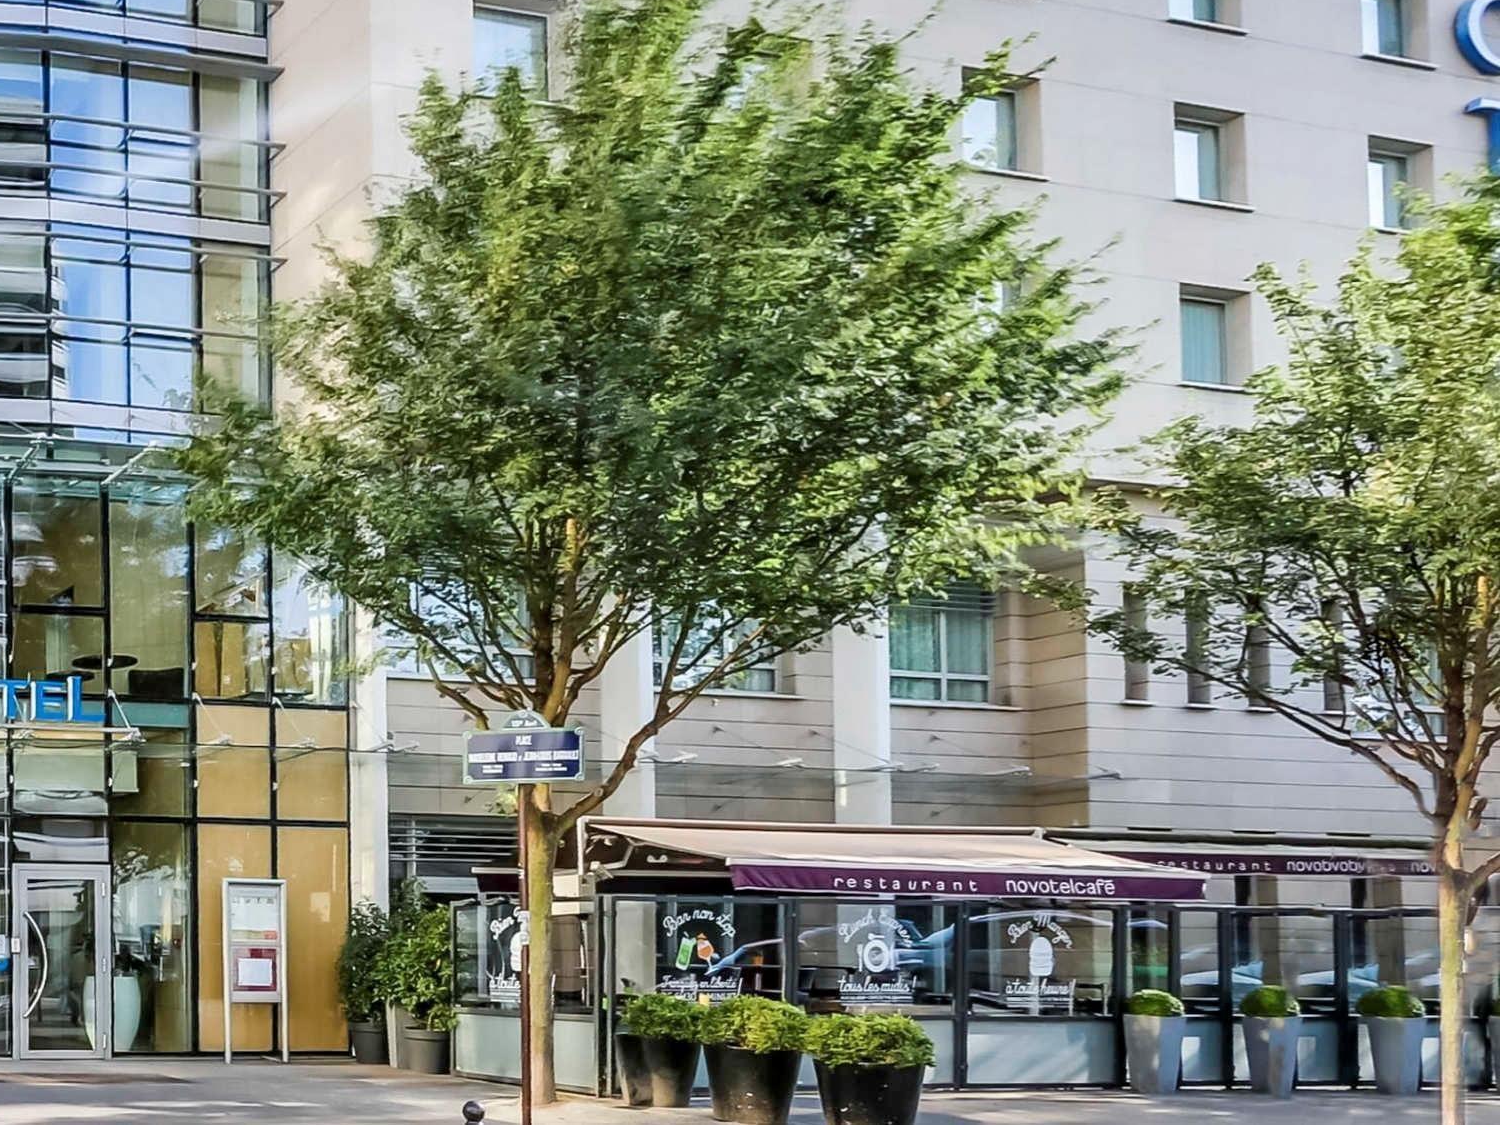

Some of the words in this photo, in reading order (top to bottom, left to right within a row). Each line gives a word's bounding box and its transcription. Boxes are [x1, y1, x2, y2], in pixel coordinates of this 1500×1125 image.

[833, 876, 978, 892] restaurant
[1006, 878, 1116, 895] novotelcafé
[692, 909, 715, 921] non
